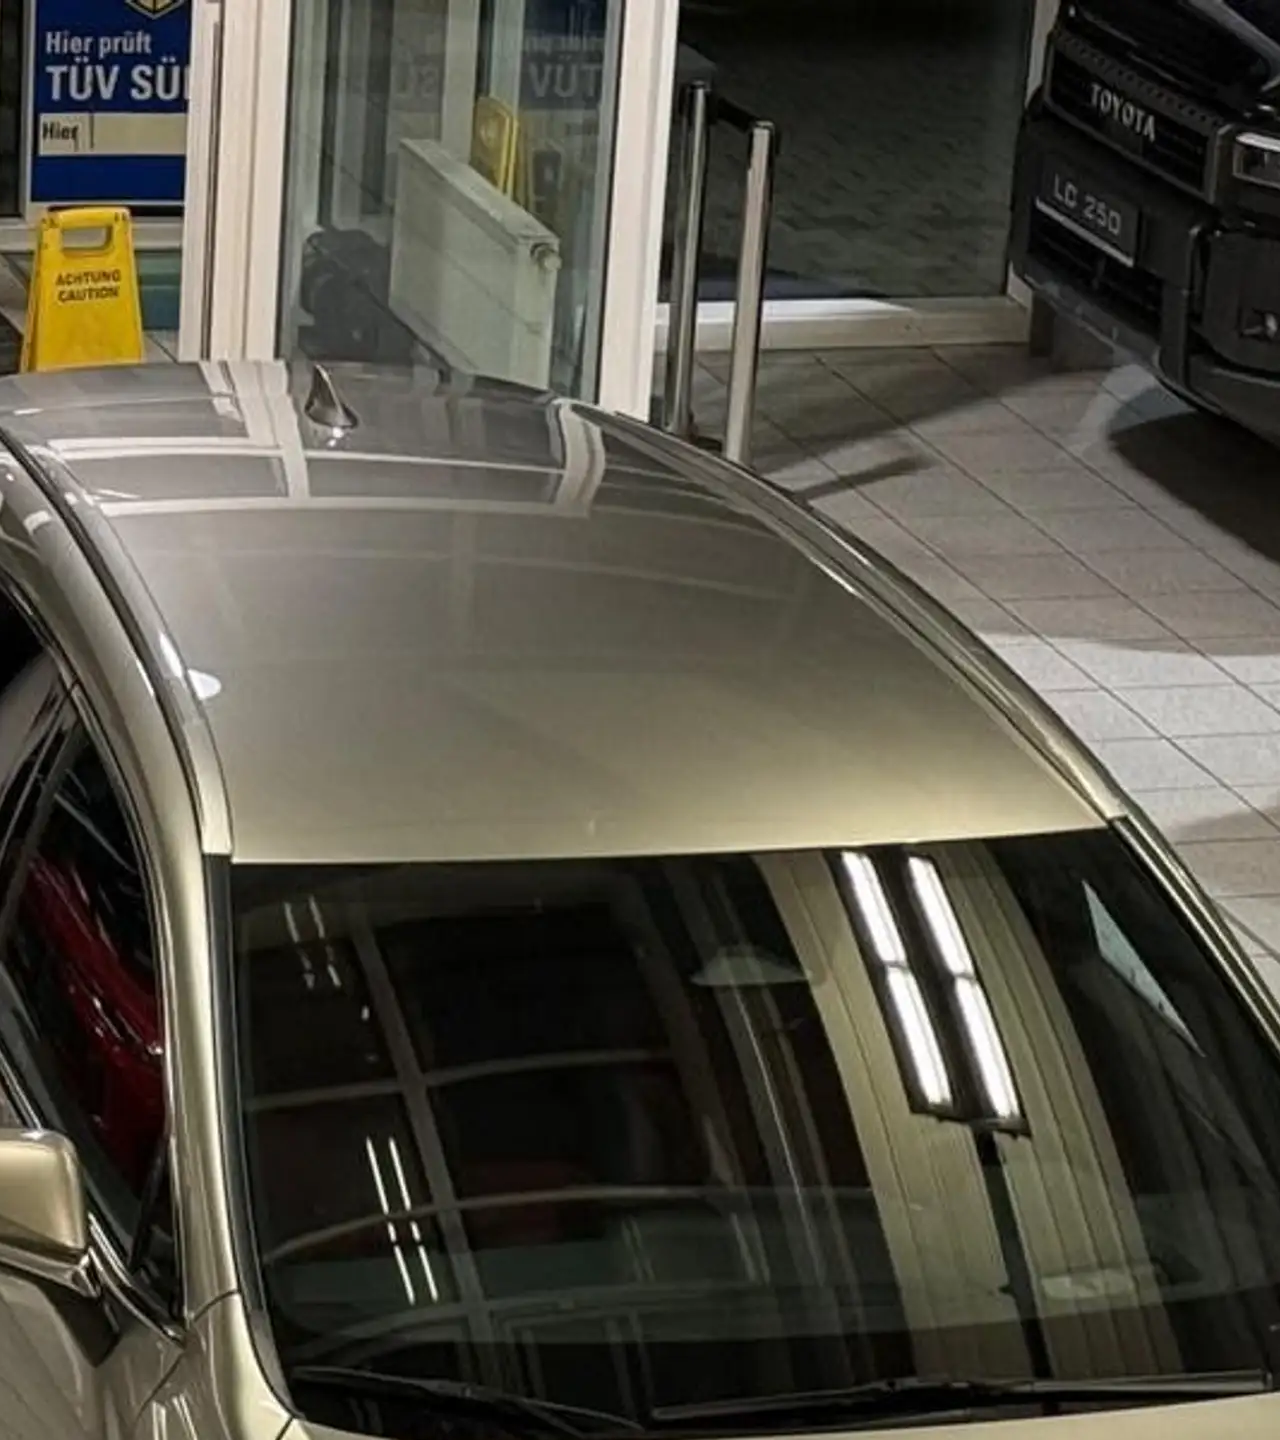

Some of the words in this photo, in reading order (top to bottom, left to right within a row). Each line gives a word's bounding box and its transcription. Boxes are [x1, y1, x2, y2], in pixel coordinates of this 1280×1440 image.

[45, 30, 93, 54] Hier
[99, 30, 152, 60] prüft
[45, 55, 120, 101] TÜV
[1090, 82, 1156, 143] TOYOTA
[1053, 173, 1078, 208] LC
[1083, 194, 1121, 235] 250
[56, 268, 121, 286] ACHTUNG
[58, 286, 119, 304] CAUTION
